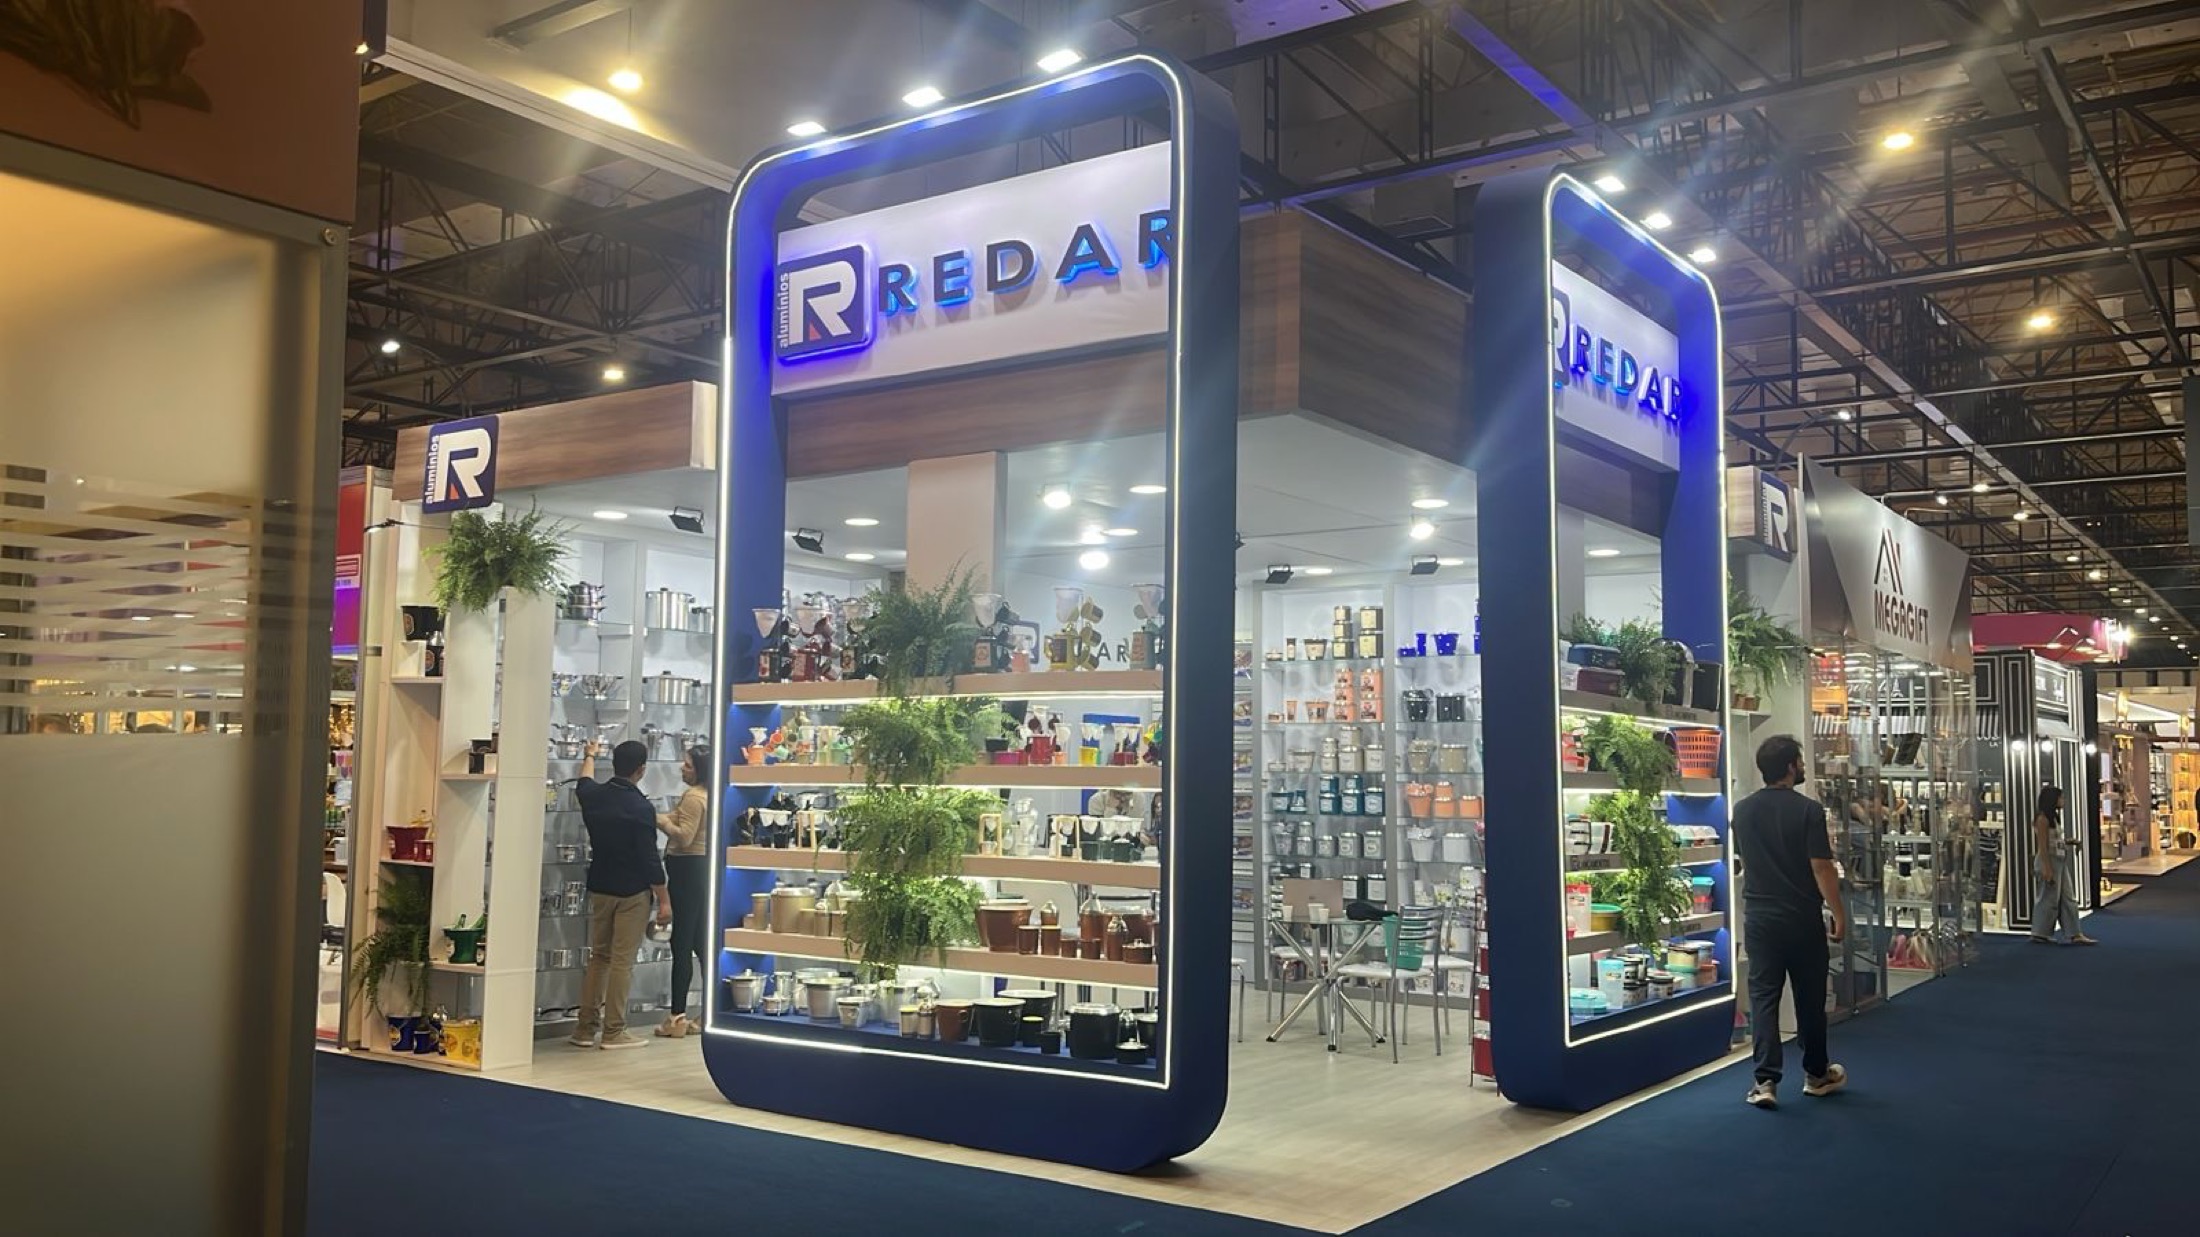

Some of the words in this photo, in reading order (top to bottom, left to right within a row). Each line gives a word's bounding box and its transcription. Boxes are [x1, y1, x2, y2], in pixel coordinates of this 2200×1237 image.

[788, 260, 857, 346] R
[878, 210, 1170, 314] REDAR
[1570, 323, 1682, 424] REDAR
[433, 428, 492, 503] R
[1874, 589, 1929, 645] MEGAGIFT
